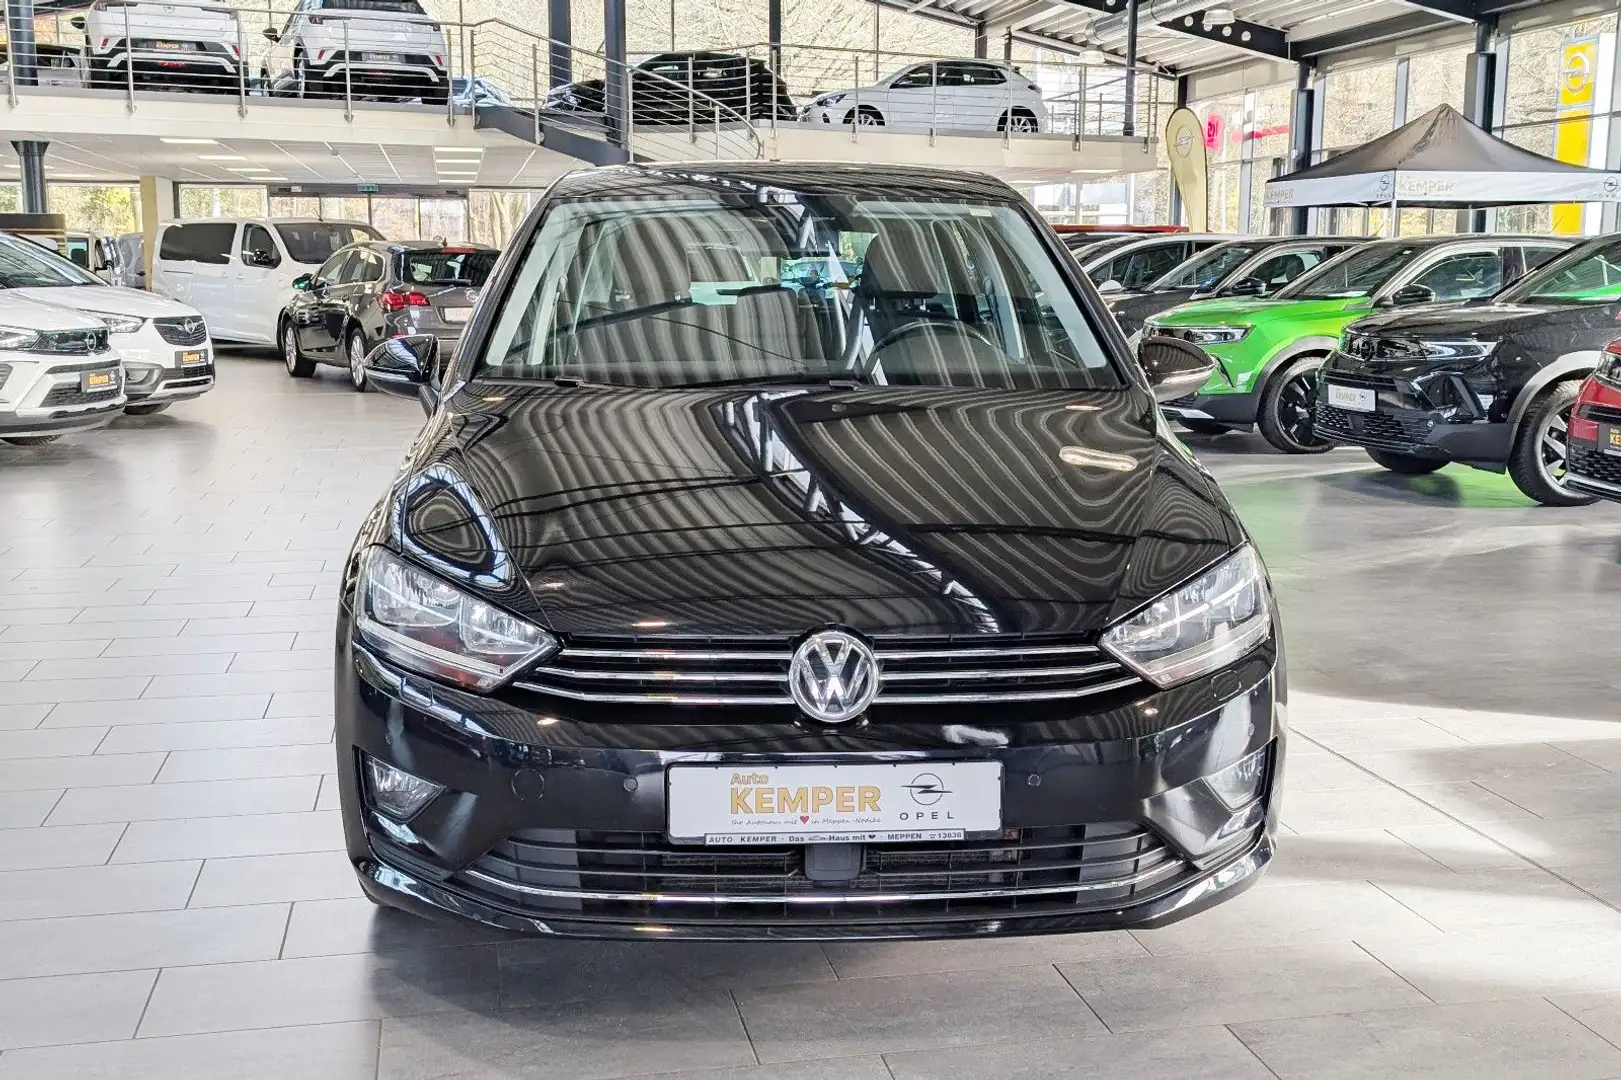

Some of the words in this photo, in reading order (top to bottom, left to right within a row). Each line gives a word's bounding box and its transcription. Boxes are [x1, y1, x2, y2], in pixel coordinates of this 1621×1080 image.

[730, 772, 769, 785] Auto
[730, 785, 882, 814] KEMPER
[899, 811, 955, 821] OPEL
[740, 835, 777, 843] KEMPER
[887, 832, 922, 840] MEPPEN
